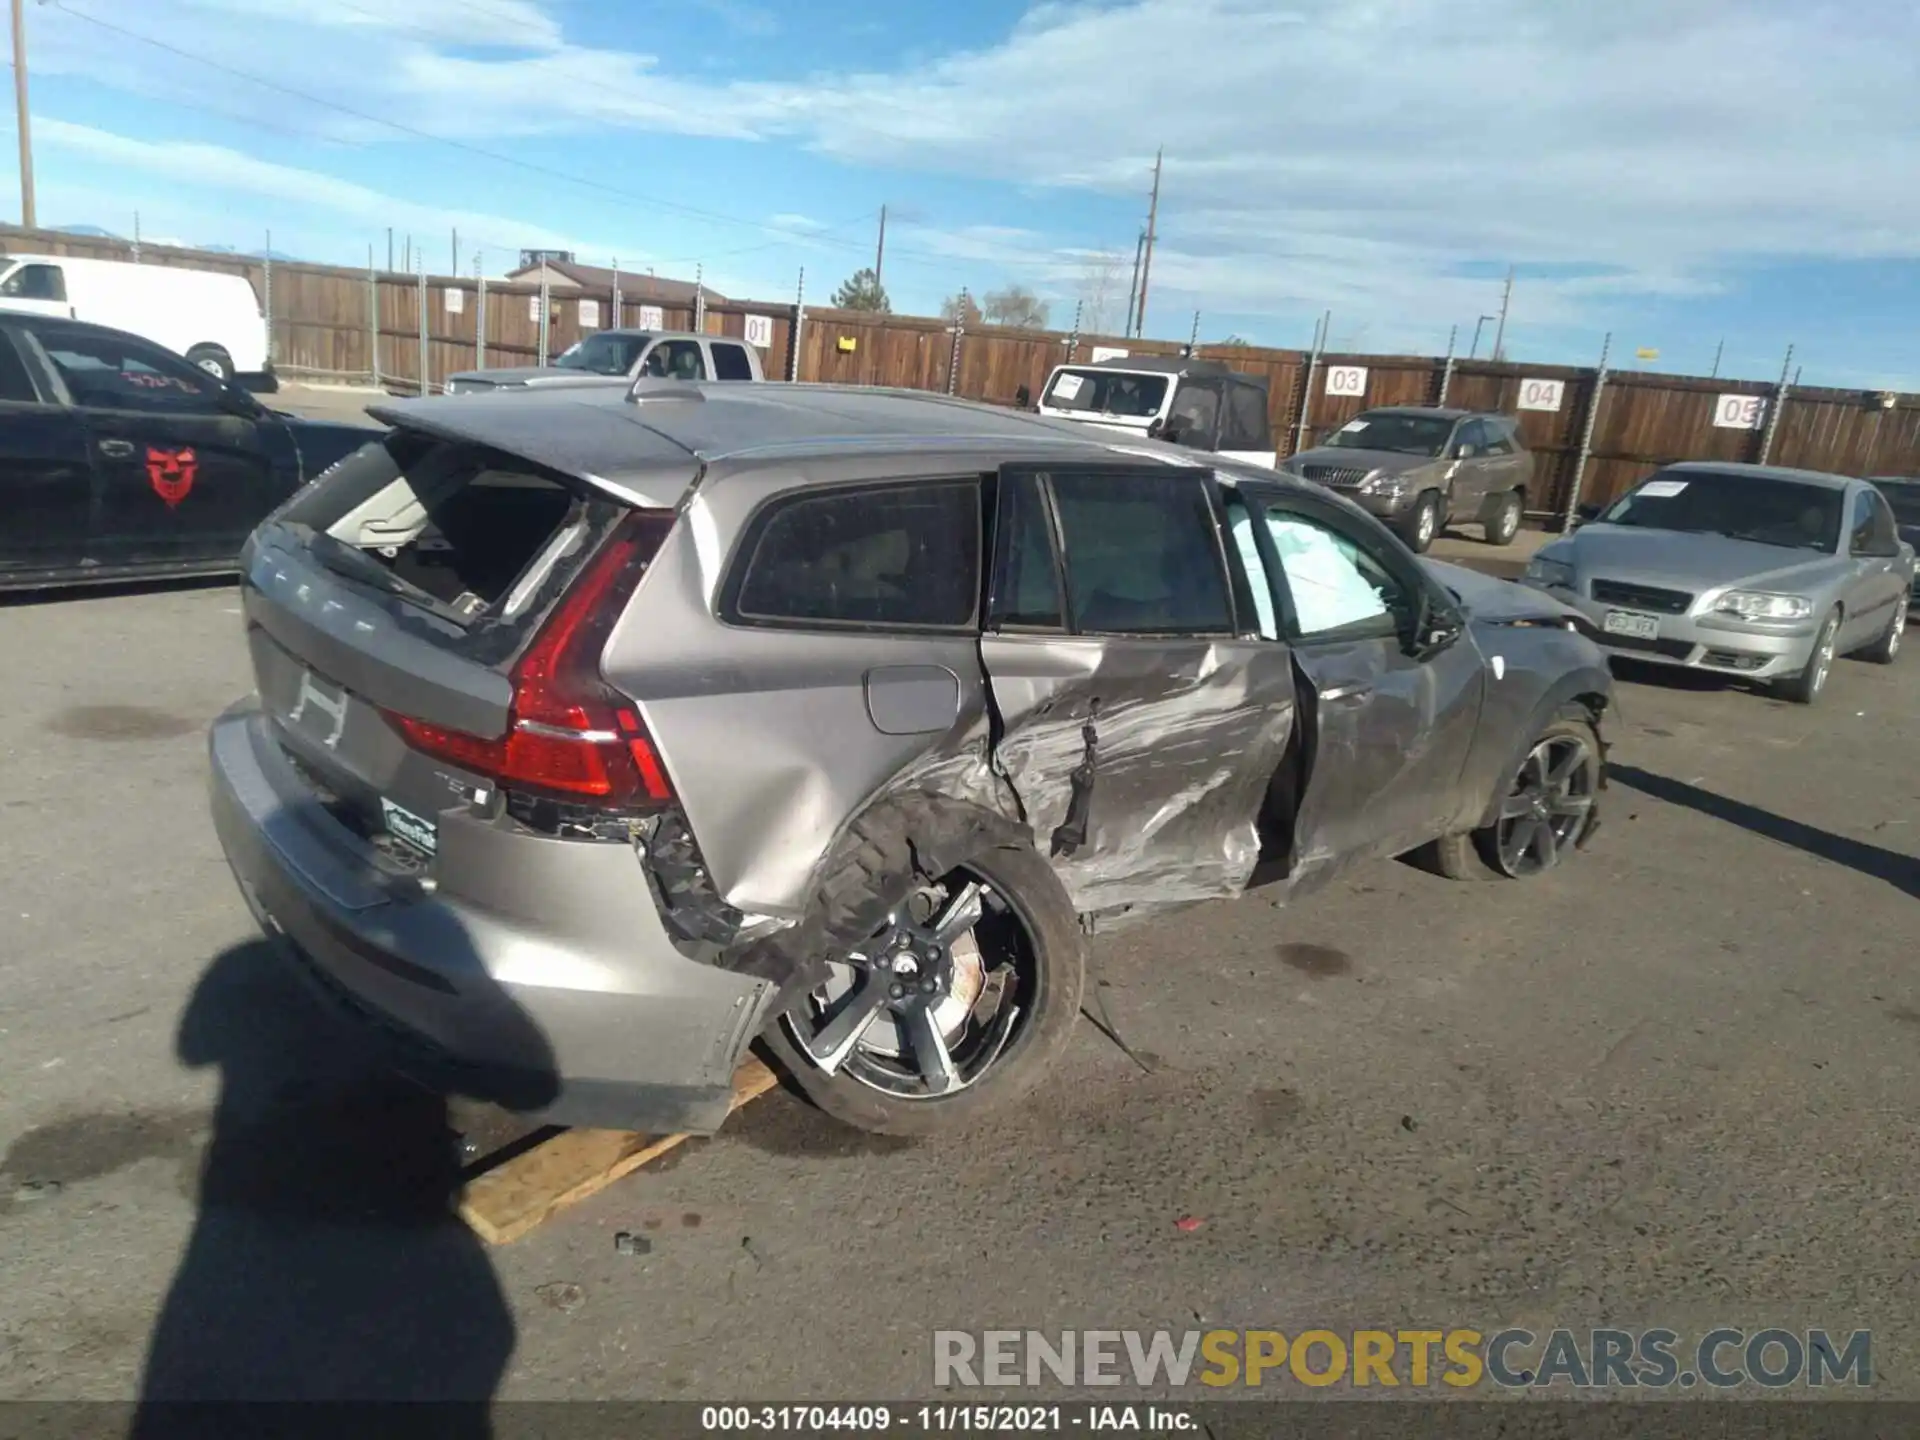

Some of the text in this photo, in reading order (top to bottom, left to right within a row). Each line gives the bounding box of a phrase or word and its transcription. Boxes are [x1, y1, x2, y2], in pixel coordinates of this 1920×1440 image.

[748, 318, 767, 341] 01
[1333, 369, 1360, 391] 03
[1525, 382, 1556, 405] 04
[1723, 398, 1758, 424] 05
